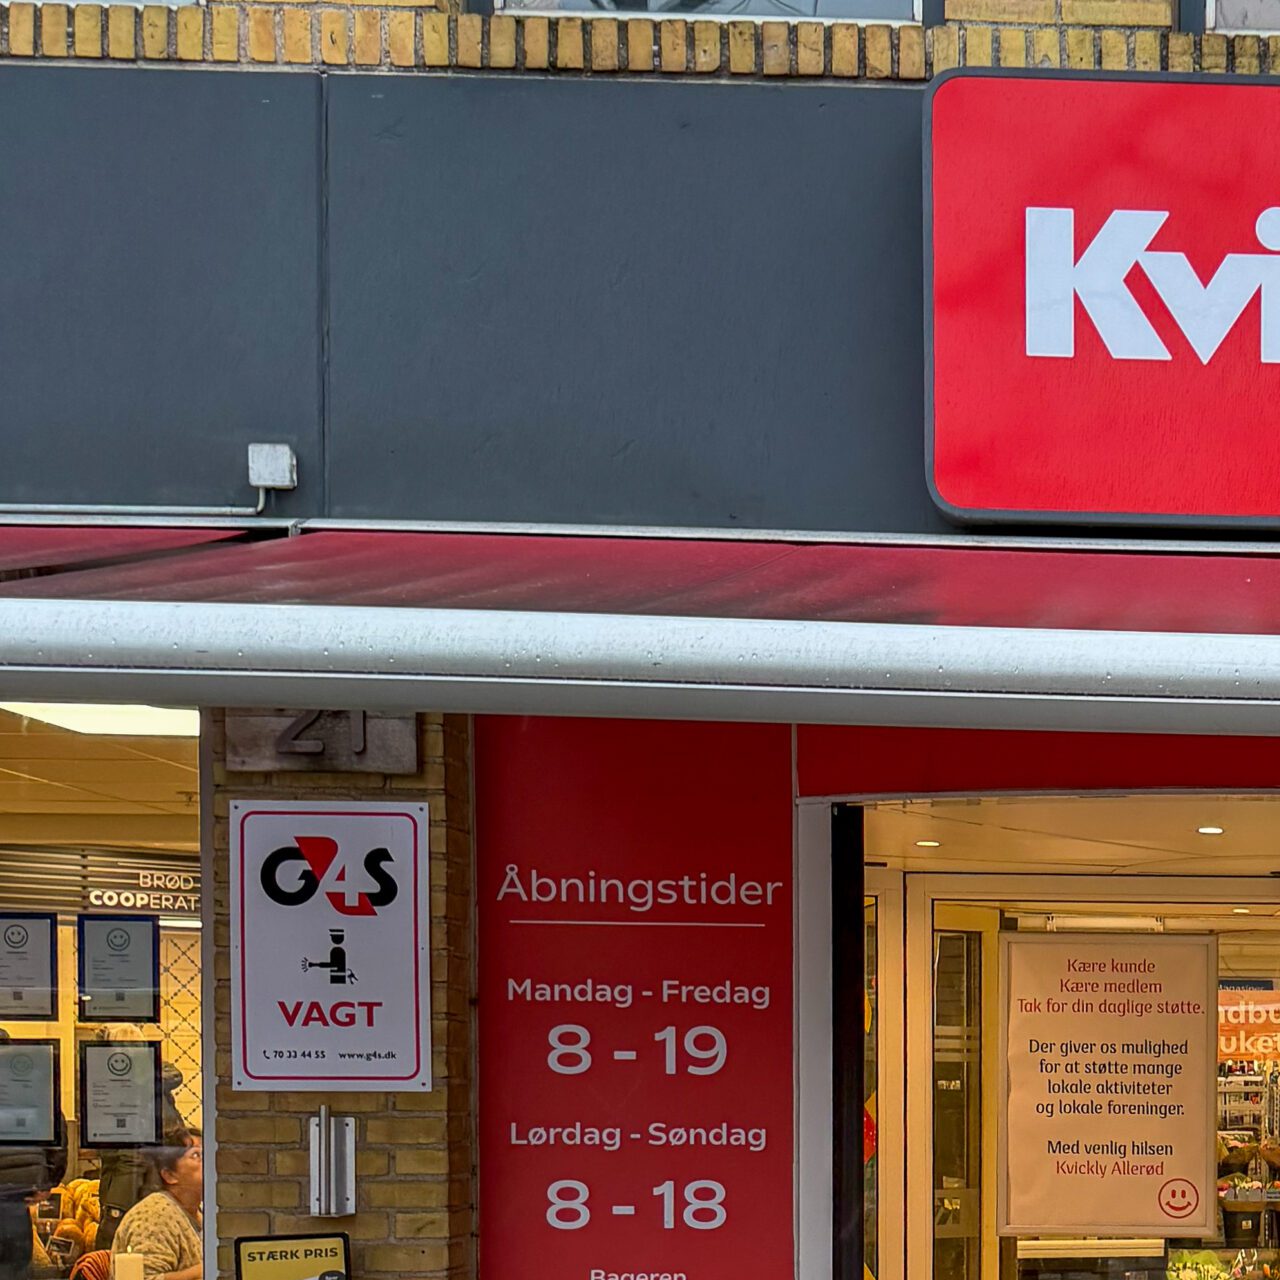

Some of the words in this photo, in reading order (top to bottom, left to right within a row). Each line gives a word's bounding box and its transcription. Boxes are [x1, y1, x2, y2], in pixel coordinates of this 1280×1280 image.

[139, 871, 194, 890] BRØD
[260, 836, 398, 916] G4S
[496, 863, 783, 912] Åbningstider
[89, 890, 199, 911] COOPERAT
[1067, 958, 1107, 974] Kære
[1111, 958, 1156, 974] kunde
[507, 978, 633, 1009] Mandag
[662, 980, 771, 1010] Fredag
[1060, 978, 1100, 994] Kære
[1104, 979, 1163, 994] medlem
[277, 1000, 383, 1027] VAGT
[1018, 998, 1041, 1013] Tak
[1046, 998, 1068, 1013] for
[1072, 998, 1094, 1014] din
[1098, 999, 1153, 1017] daglige
[1157, 1000, 1206, 1015] støtte.
[272, 1050, 284, 1059] 70
[286, 1050, 297, 1059] 33
[300, 1050, 312, 1059] 44
[314, 1050, 326, 1059] 55
[338, 1050, 397, 1061] www.g4s.dk
[547, 1024, 592, 1075] 8
[613, 1050, 637, 1060] -
[654, 1025, 728, 1076] 19
[1029, 1039, 1056, 1054] Der
[1060, 1039, 1097, 1057] giver
[1100, 1043, 1117, 1054] os
[1121, 1039, 1189, 1058] mulighed
[1039, 1059, 1061, 1074] for
[1064, 1061, 1080, 1074] at
[1084, 1060, 1129, 1075] støtte
[1132, 1064, 1183, 1078] mange
[1047, 1079, 1092, 1094] lokale
[1096, 1079, 1173, 1095] aktiviteter
[1036, 1102, 1054, 1117] og
[1059, 1099, 1103, 1115] lokale
[1107, 1100, 1185, 1119] foreninger.
[510, 1122, 621, 1151] Lørdag
[648, 1122, 767, 1151] Søndag
[1047, 1140, 1080, 1155] Med
[1084, 1140, 1127, 1159] venlig
[1131, 1141, 1174, 1156] hilsen
[1056, 1160, 1107, 1178] Kvickly
[1111, 1160, 1164, 1176] Allerød
[546, 1179, 591, 1230] 8
[612, 1205, 635, 1215] -
[652, 1179, 727, 1230] 18
[247, 1249, 300, 1262] STÆRK
[304, 1247, 338, 1259] PRIS
